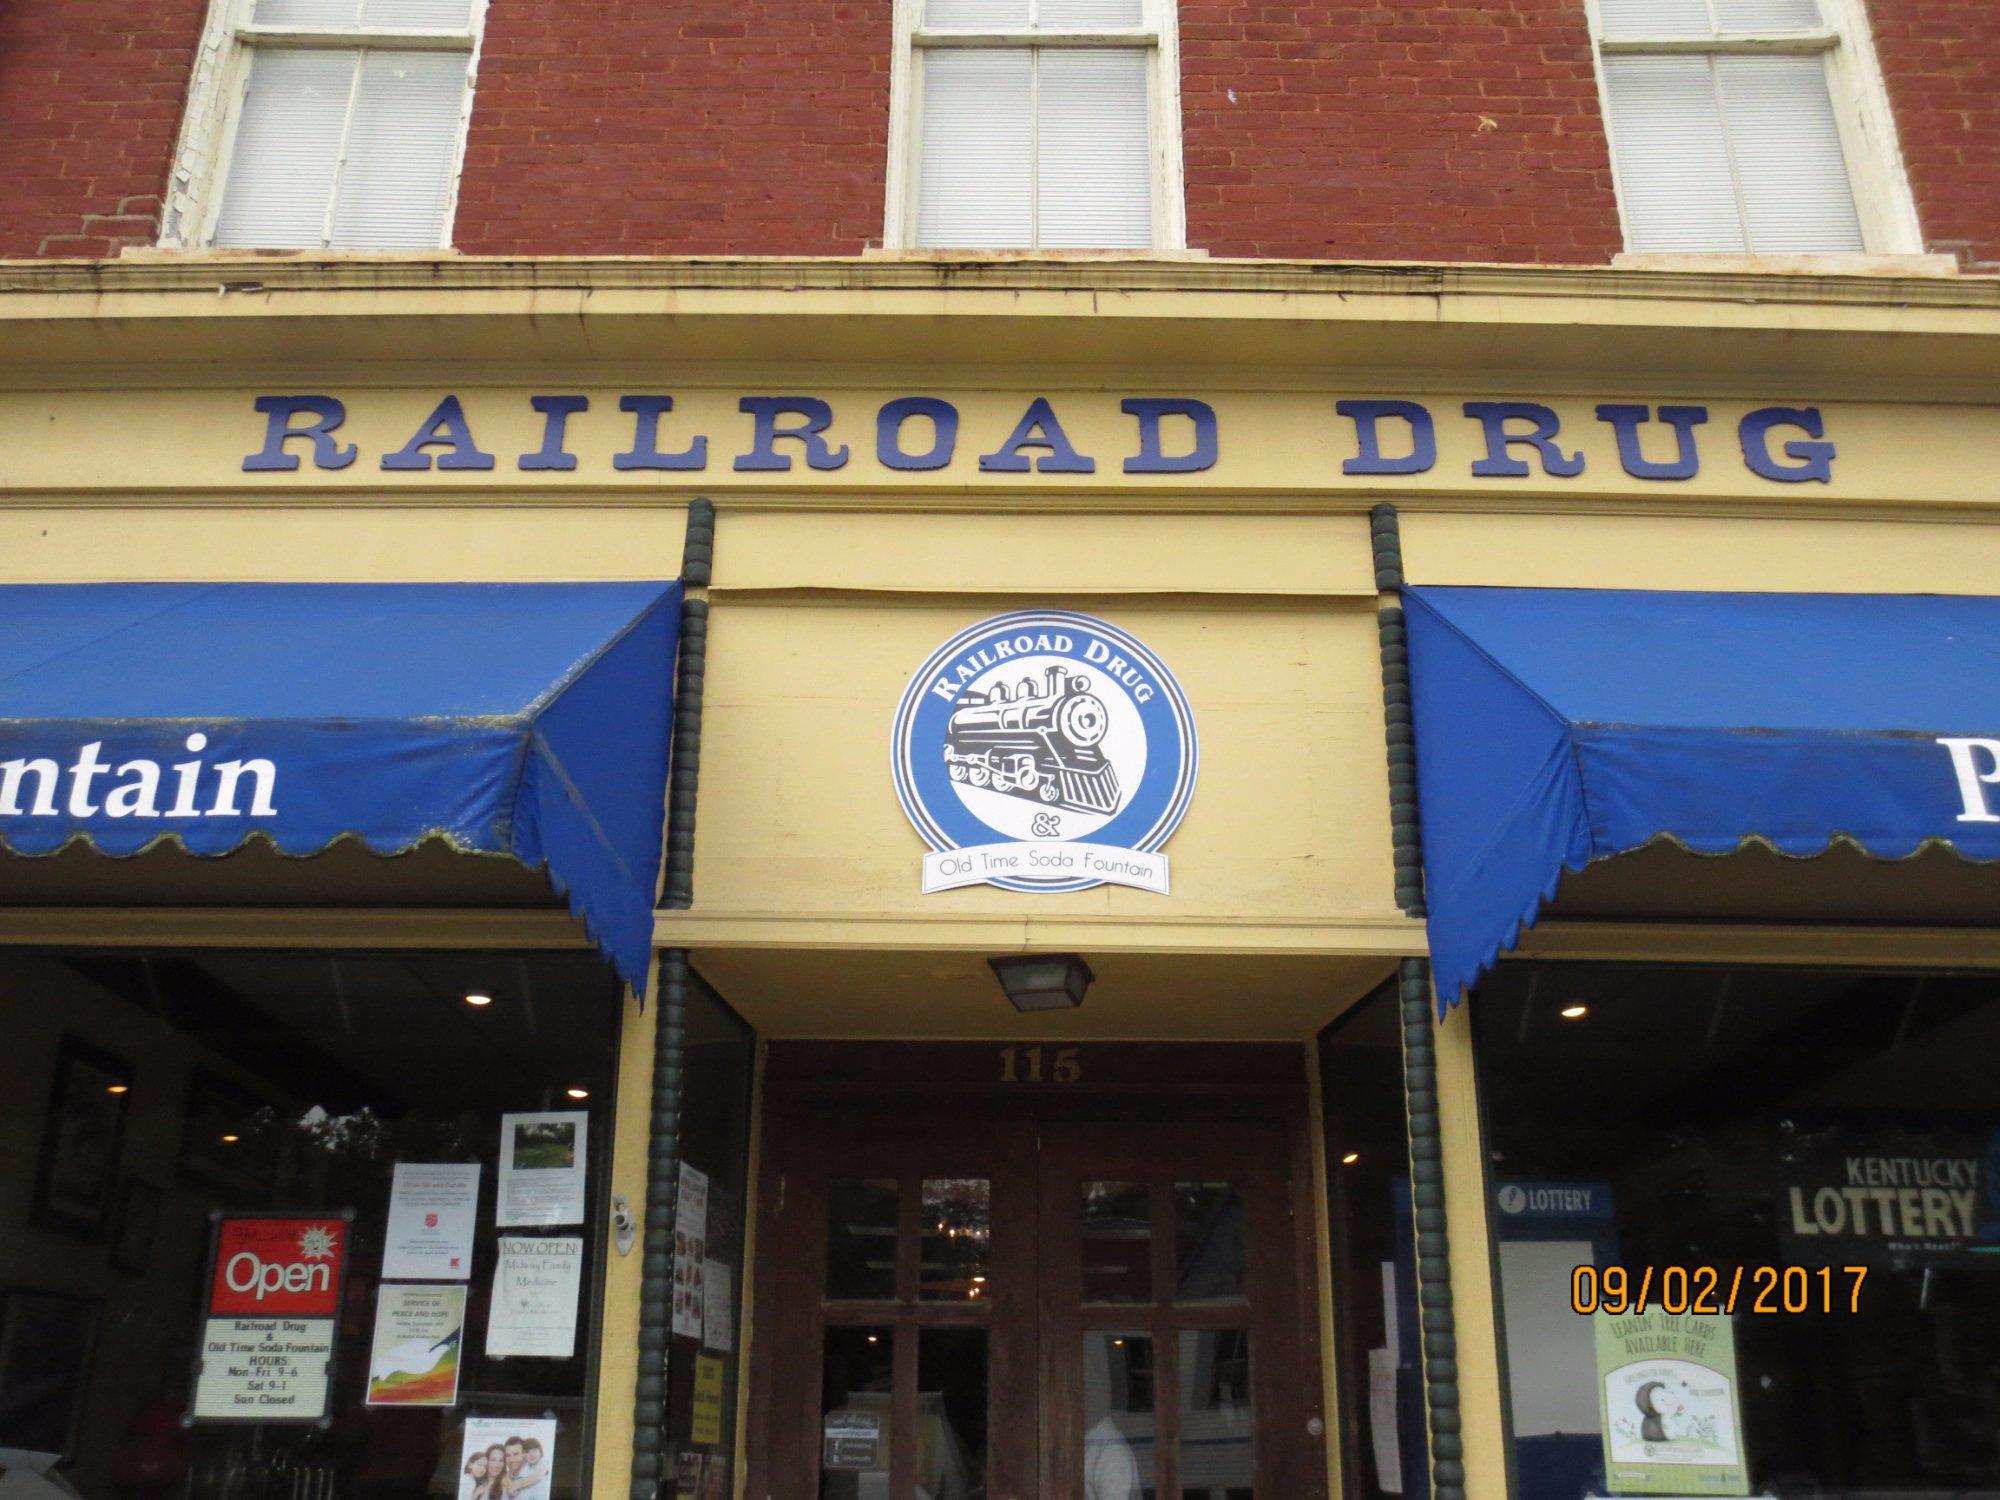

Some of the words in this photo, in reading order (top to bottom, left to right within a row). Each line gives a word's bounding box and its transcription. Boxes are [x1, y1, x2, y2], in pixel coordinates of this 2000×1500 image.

[242, 394, 1216, 473] RAILROAD
[1336, 400, 1836, 484] DRUG
[0, 732, 278, 818] ntain
[1031, 812, 1060, 837] &
[939, 857, 973, 877] Old
[980, 852, 1019, 870] Time
[1028, 850, 1074, 868] Soda
[1083, 851, 1154, 880] Fountain
[1000, 1046, 1081, 1083] 115
[1846, 1157, 1978, 1186] KENTUCKY
[1528, 1188, 1592, 1211] LOTTERY
[1789, 1186, 1978, 1237] LOTTERY
[503, 1241, 535, 1255] NOW
[225, 1252, 330, 1301] Open
[234, 1321, 277, 1331] Railroad
[282, 1321, 307, 1333] Drug
[266, 1332, 274, 1341] &
[208, 1342, 226, 1352] Old
[230, 1342, 255, 1352] Time
[258, 1342, 283, 1352] Soda
[285, 1342, 330, 1353] Fountain
[1624, 1333, 1678, 1355] AVAILABLE
[1684, 1335, 1707, 1358] HERE
[228, 1366, 271, 1377] Mon-Fri
[278, 1367, 298, 1377] 9-6
[247, 1380, 264, 1390] Sat
[234, 1394, 254, 1404] Sun
[259, 1394, 295, 1404] Closed
